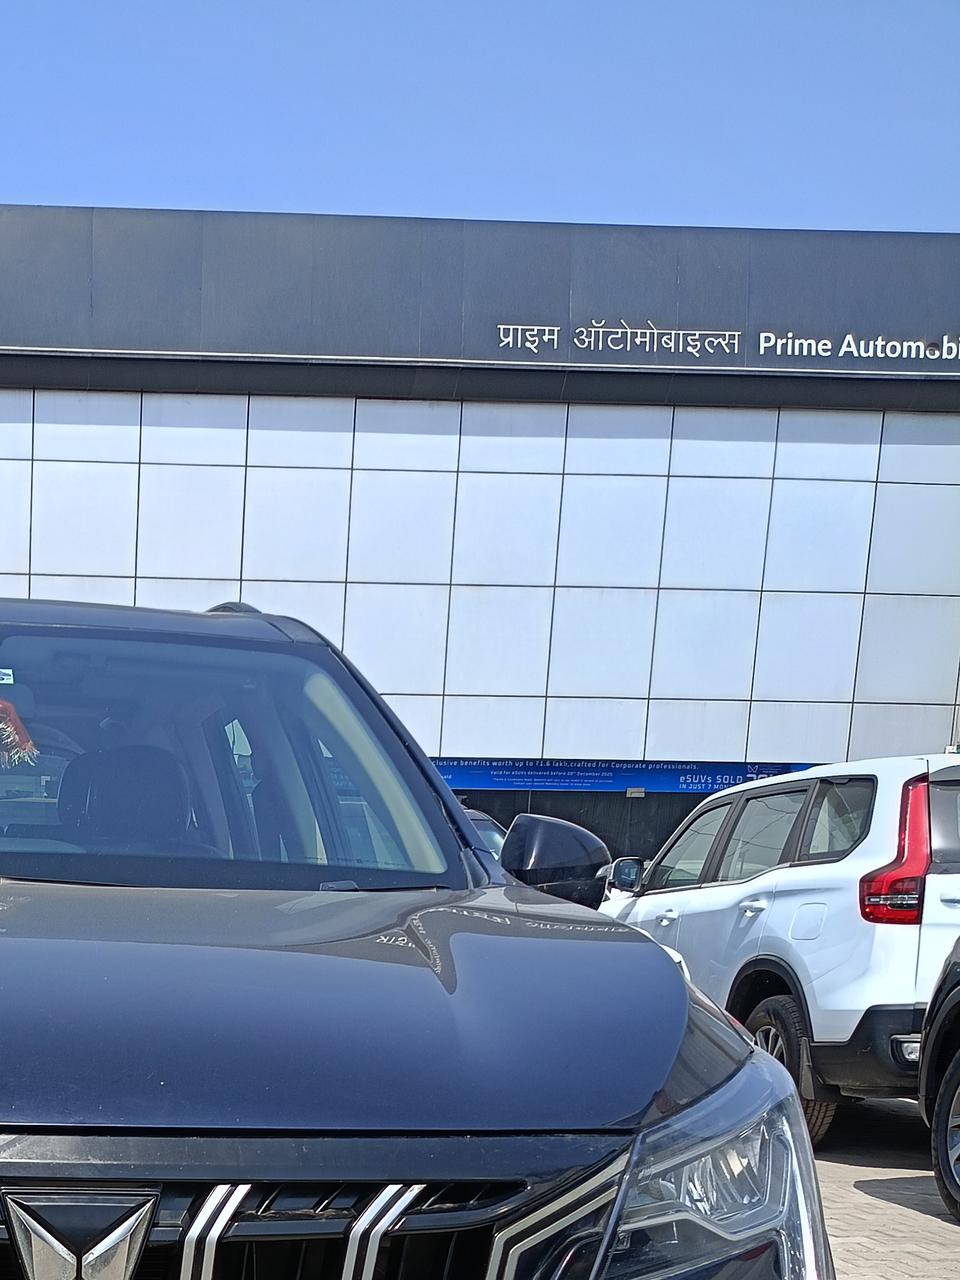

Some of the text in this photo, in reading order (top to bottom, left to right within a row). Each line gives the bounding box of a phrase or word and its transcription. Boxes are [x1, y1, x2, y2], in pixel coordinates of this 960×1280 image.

[496, 319, 742, 358] प्राइम ऑटोमोबाइल्स
[759, 331, 960, 360] Prime Automob
[679, 774, 712, 784] eSUVs
[716, 775, 743, 784] SOLD
